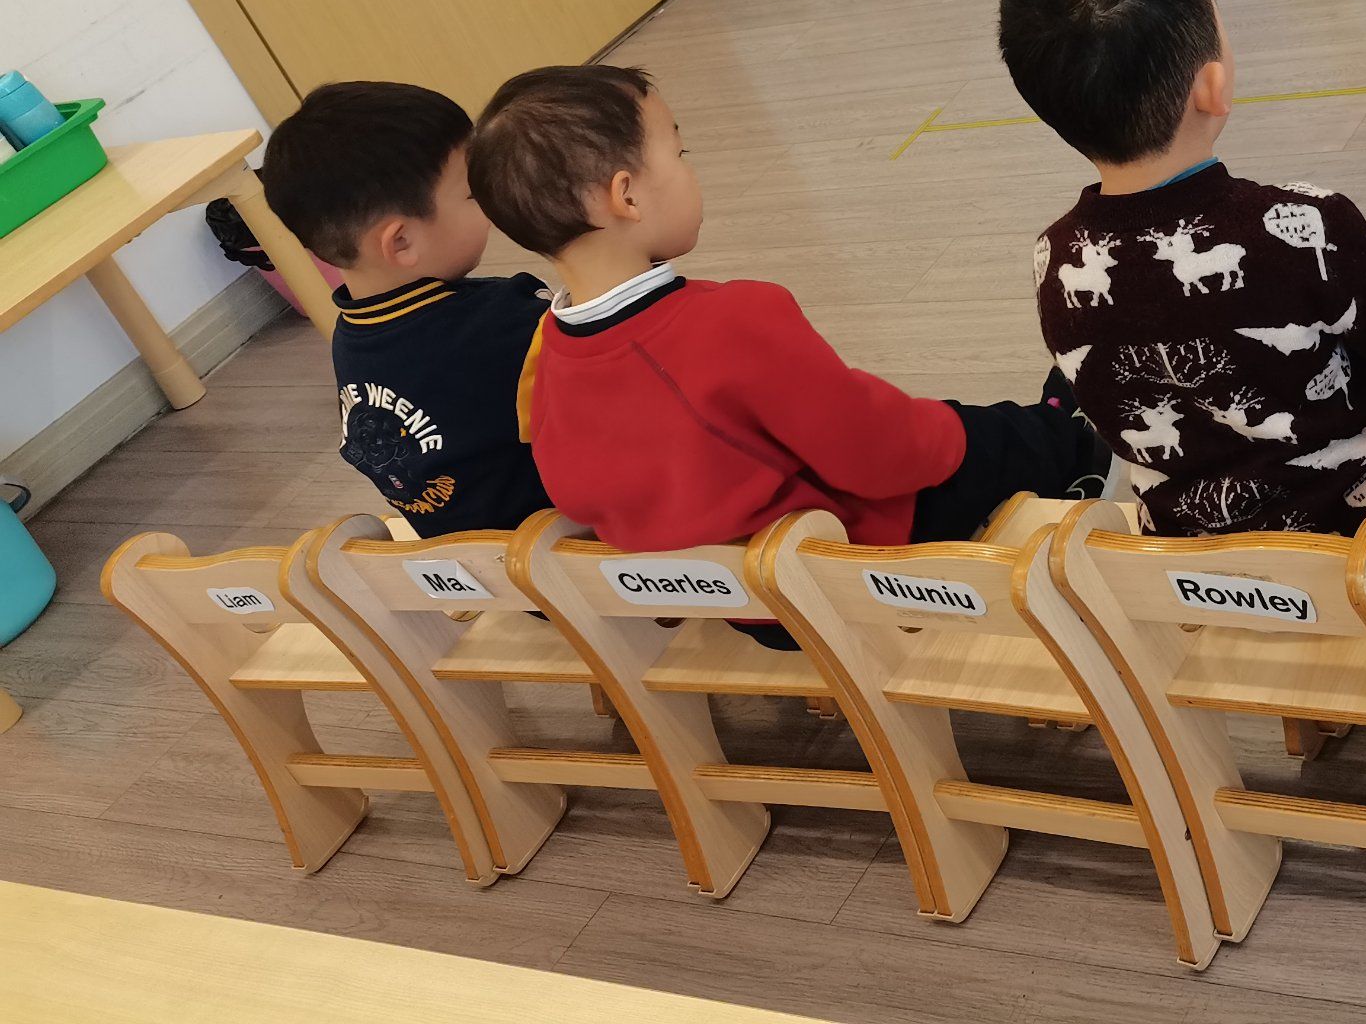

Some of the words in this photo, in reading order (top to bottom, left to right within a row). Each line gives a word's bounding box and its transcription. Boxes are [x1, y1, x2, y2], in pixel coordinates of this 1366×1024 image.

[364, 382, 443, 454] WEENIE
[422, 573, 476, 592] Ma
[617, 572, 732, 595] Charles
[869, 573, 976, 610] Niuniu
[216, 594, 262, 608] Liam
[1176, 578, 1308, 620] Rowley
